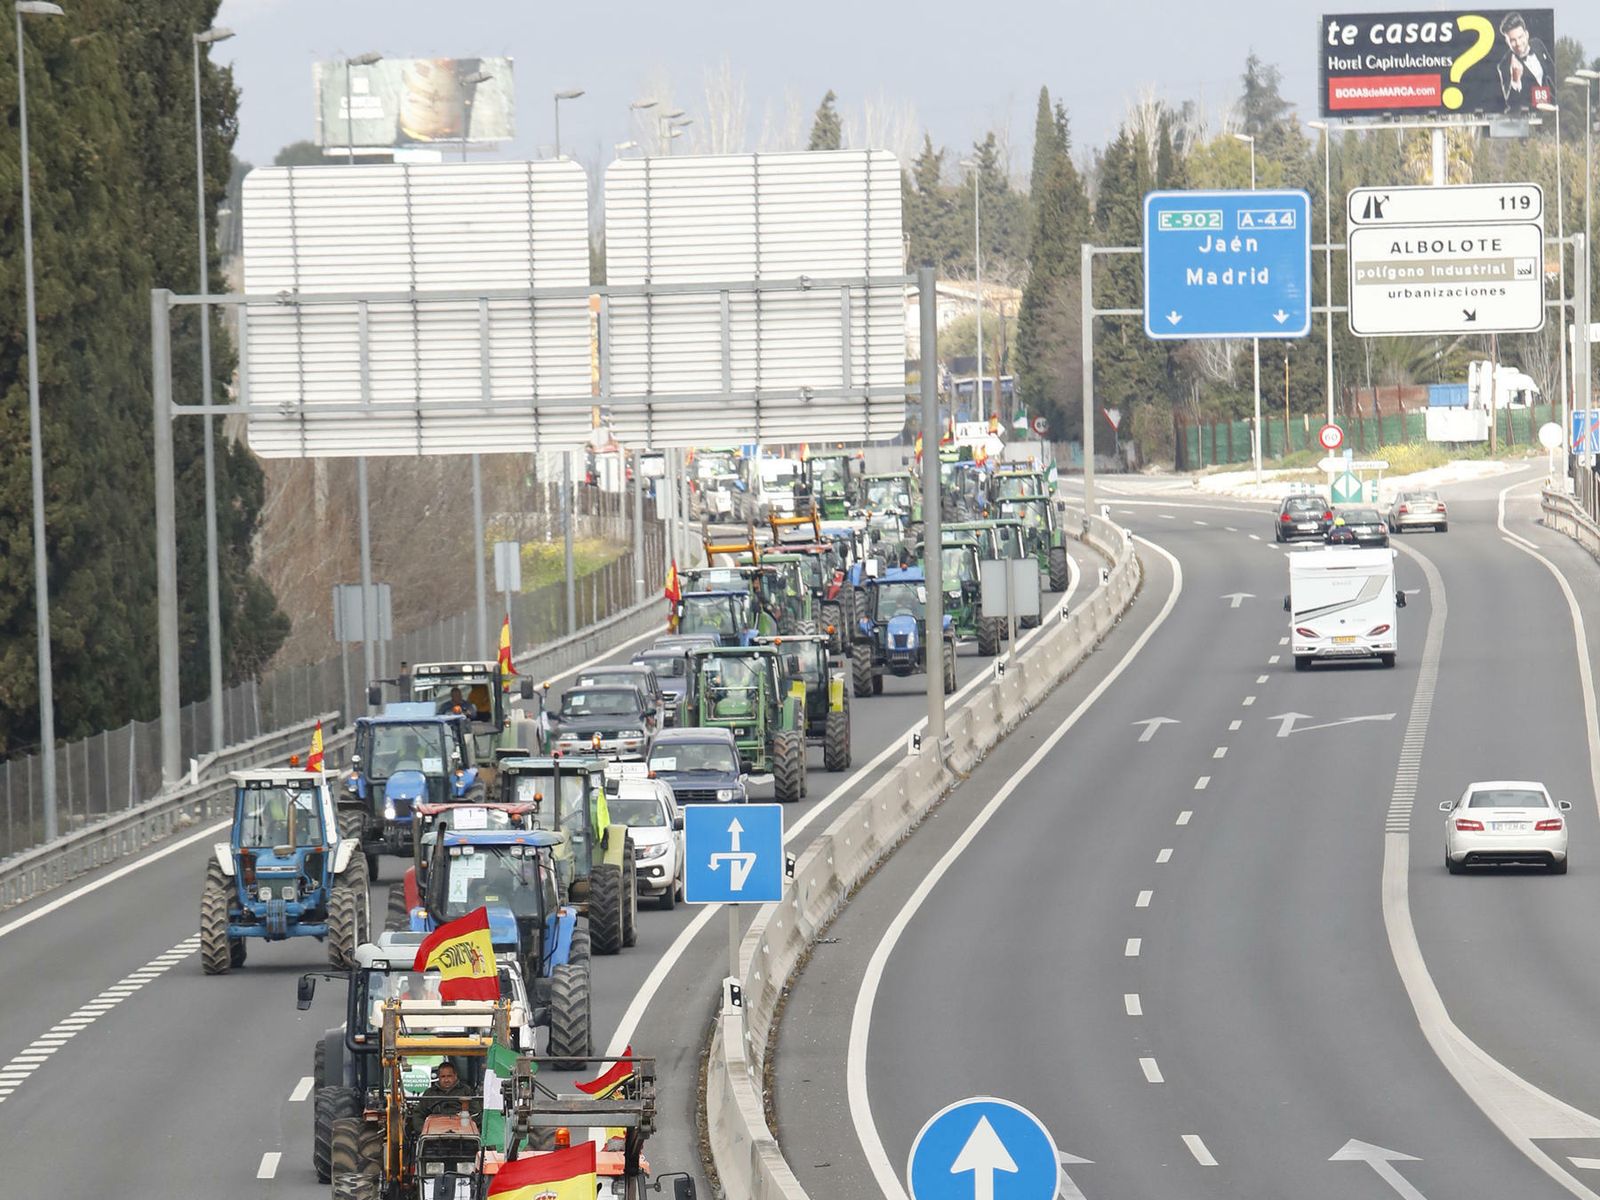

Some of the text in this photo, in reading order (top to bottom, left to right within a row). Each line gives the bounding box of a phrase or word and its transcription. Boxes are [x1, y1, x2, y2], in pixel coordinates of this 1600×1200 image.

[1328, 21, 1359, 46] te
[1370, 22, 1453, 45] casas
[1499, 195, 1531, 210] 119
[1161, 213, 1220, 228] E-902
[1241, 212, 1293, 227] A-44
[1198, 235, 1258, 253] Jaén
[1390, 238, 1503, 255] ALBOLOTE
[1186, 267, 1269, 286] Madrid
[1357, 262, 1507, 281] polígono industrial
[1388, 286, 1507, 299] urbanizaciones
